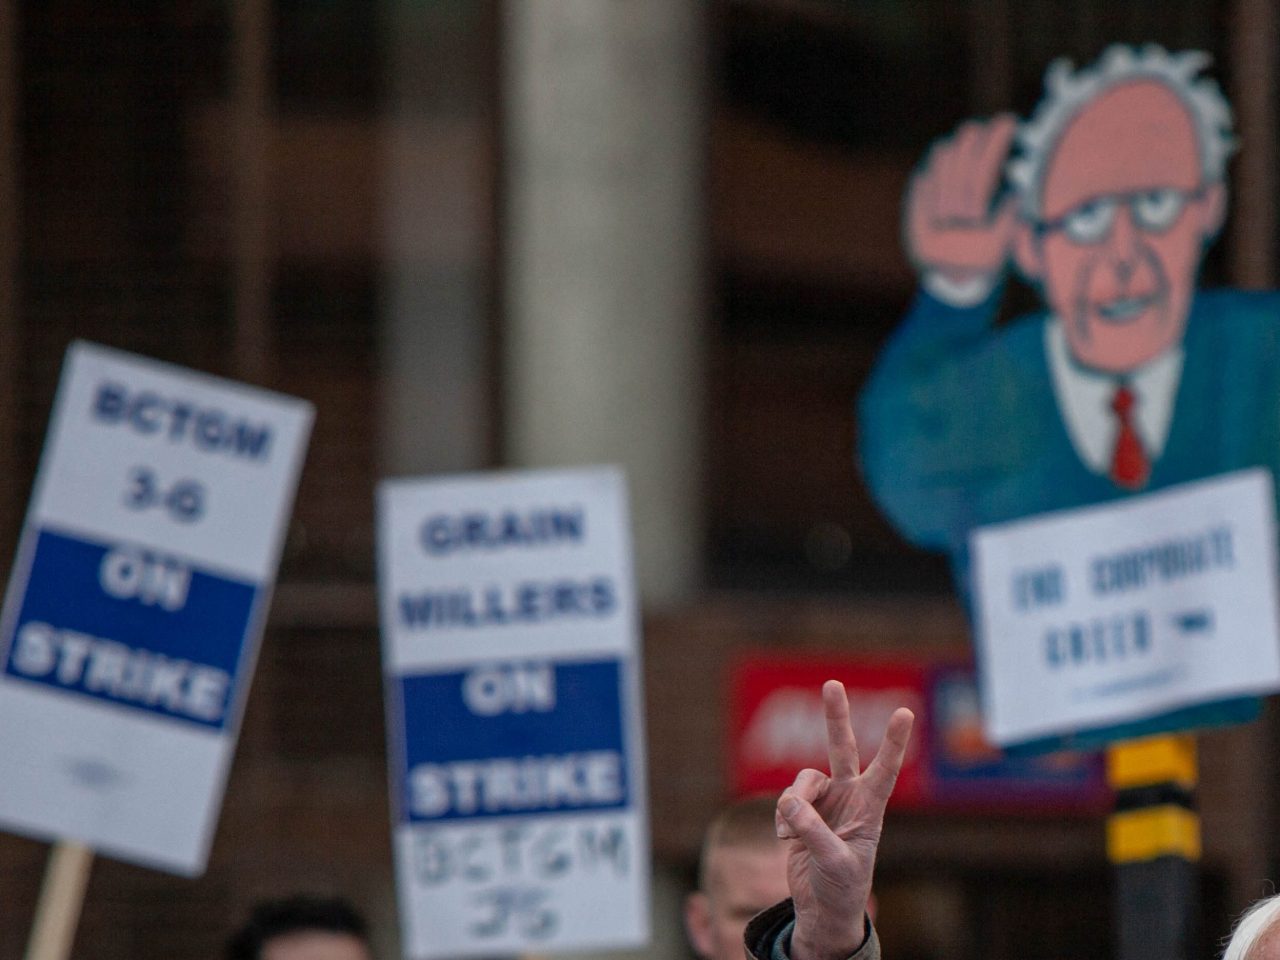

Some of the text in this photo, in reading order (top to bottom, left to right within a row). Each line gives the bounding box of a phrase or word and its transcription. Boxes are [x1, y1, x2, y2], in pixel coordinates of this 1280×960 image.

[418, 508, 585, 558] GRAIN
[100, 548, 192, 612] ON
[399, 577, 617, 630] MILLERS
[12, 622, 229, 722] STRIKE
[461, 664, 557, 716] ON
[407, 753, 621, 817] STRIKE
